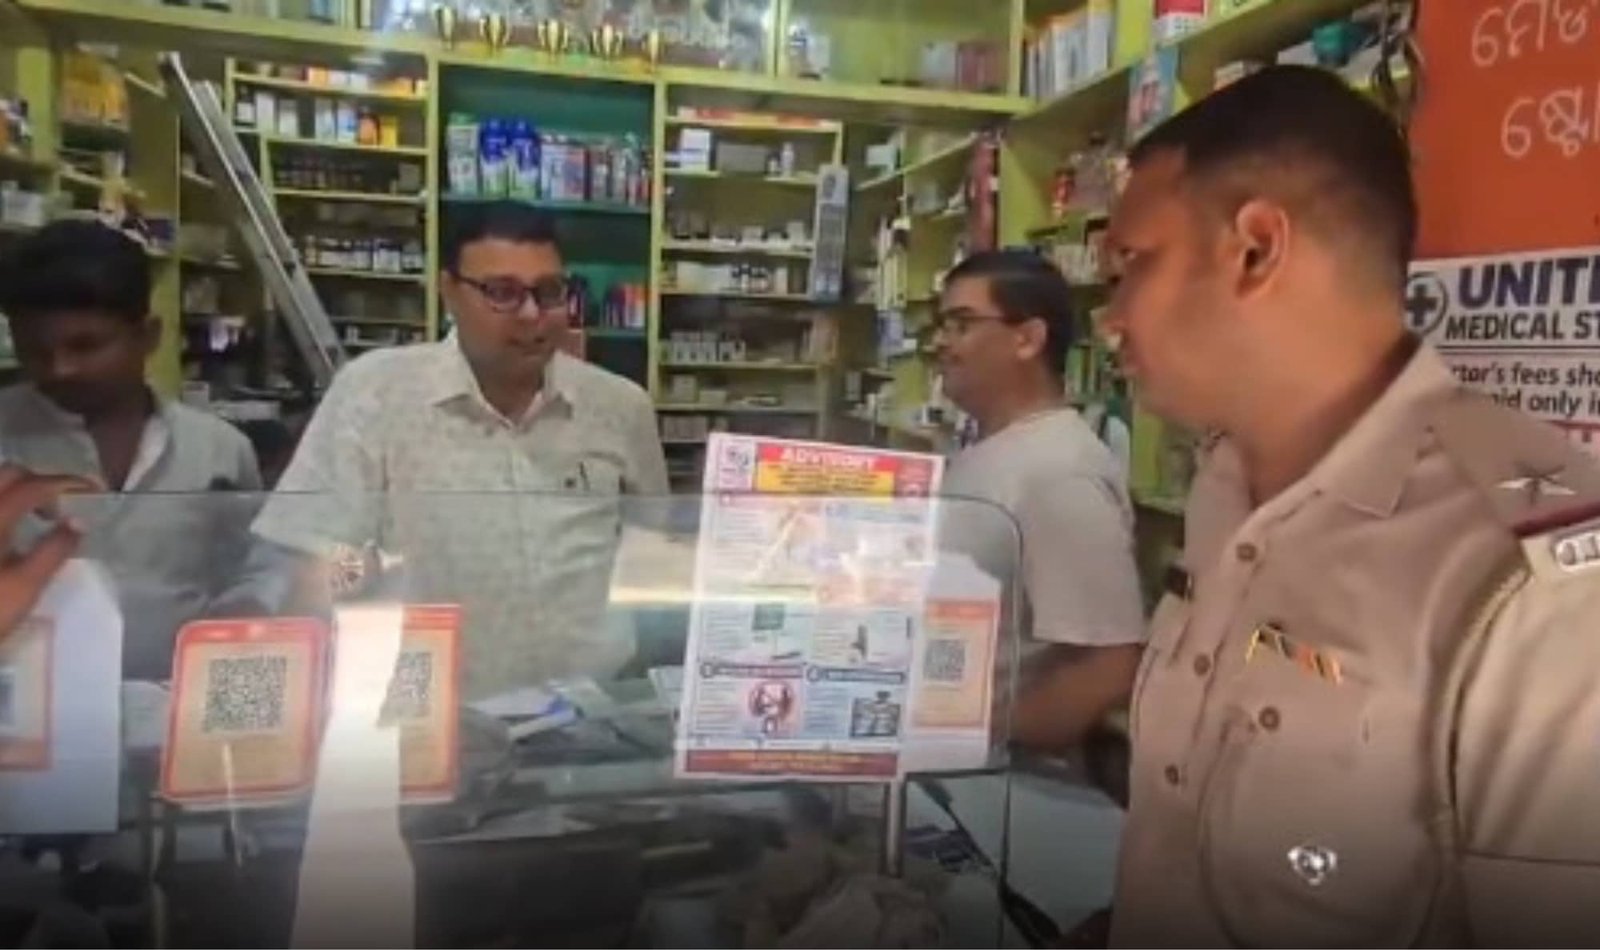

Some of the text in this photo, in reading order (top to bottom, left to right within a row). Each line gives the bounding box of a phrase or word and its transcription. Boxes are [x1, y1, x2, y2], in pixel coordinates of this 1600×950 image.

[1446, 312, 1566, 341] MEDICAL
[1511, 361, 1560, 386] fees
[1529, 390, 1582, 418] only
